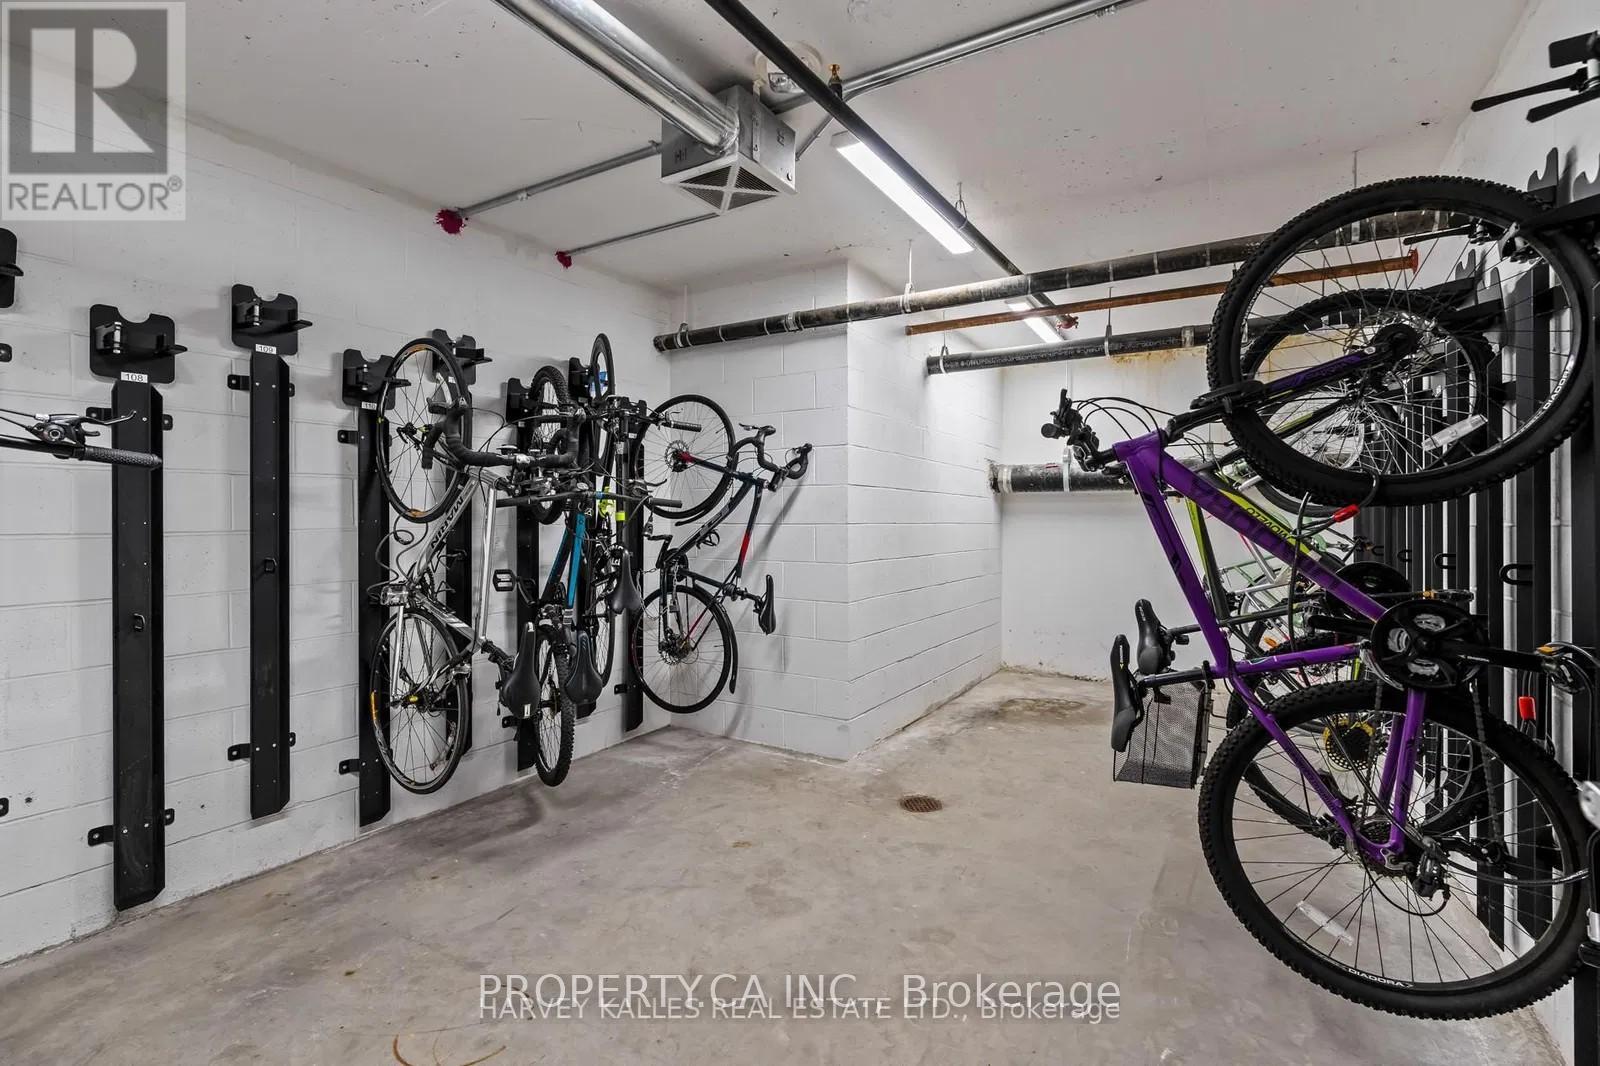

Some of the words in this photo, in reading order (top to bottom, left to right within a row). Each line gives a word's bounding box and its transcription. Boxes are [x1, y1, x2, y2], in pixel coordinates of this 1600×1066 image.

[125, 373, 144, 382] 108
[431, 497, 464, 549] MARIN
[1348, 968, 1404, 989] DIADORA
